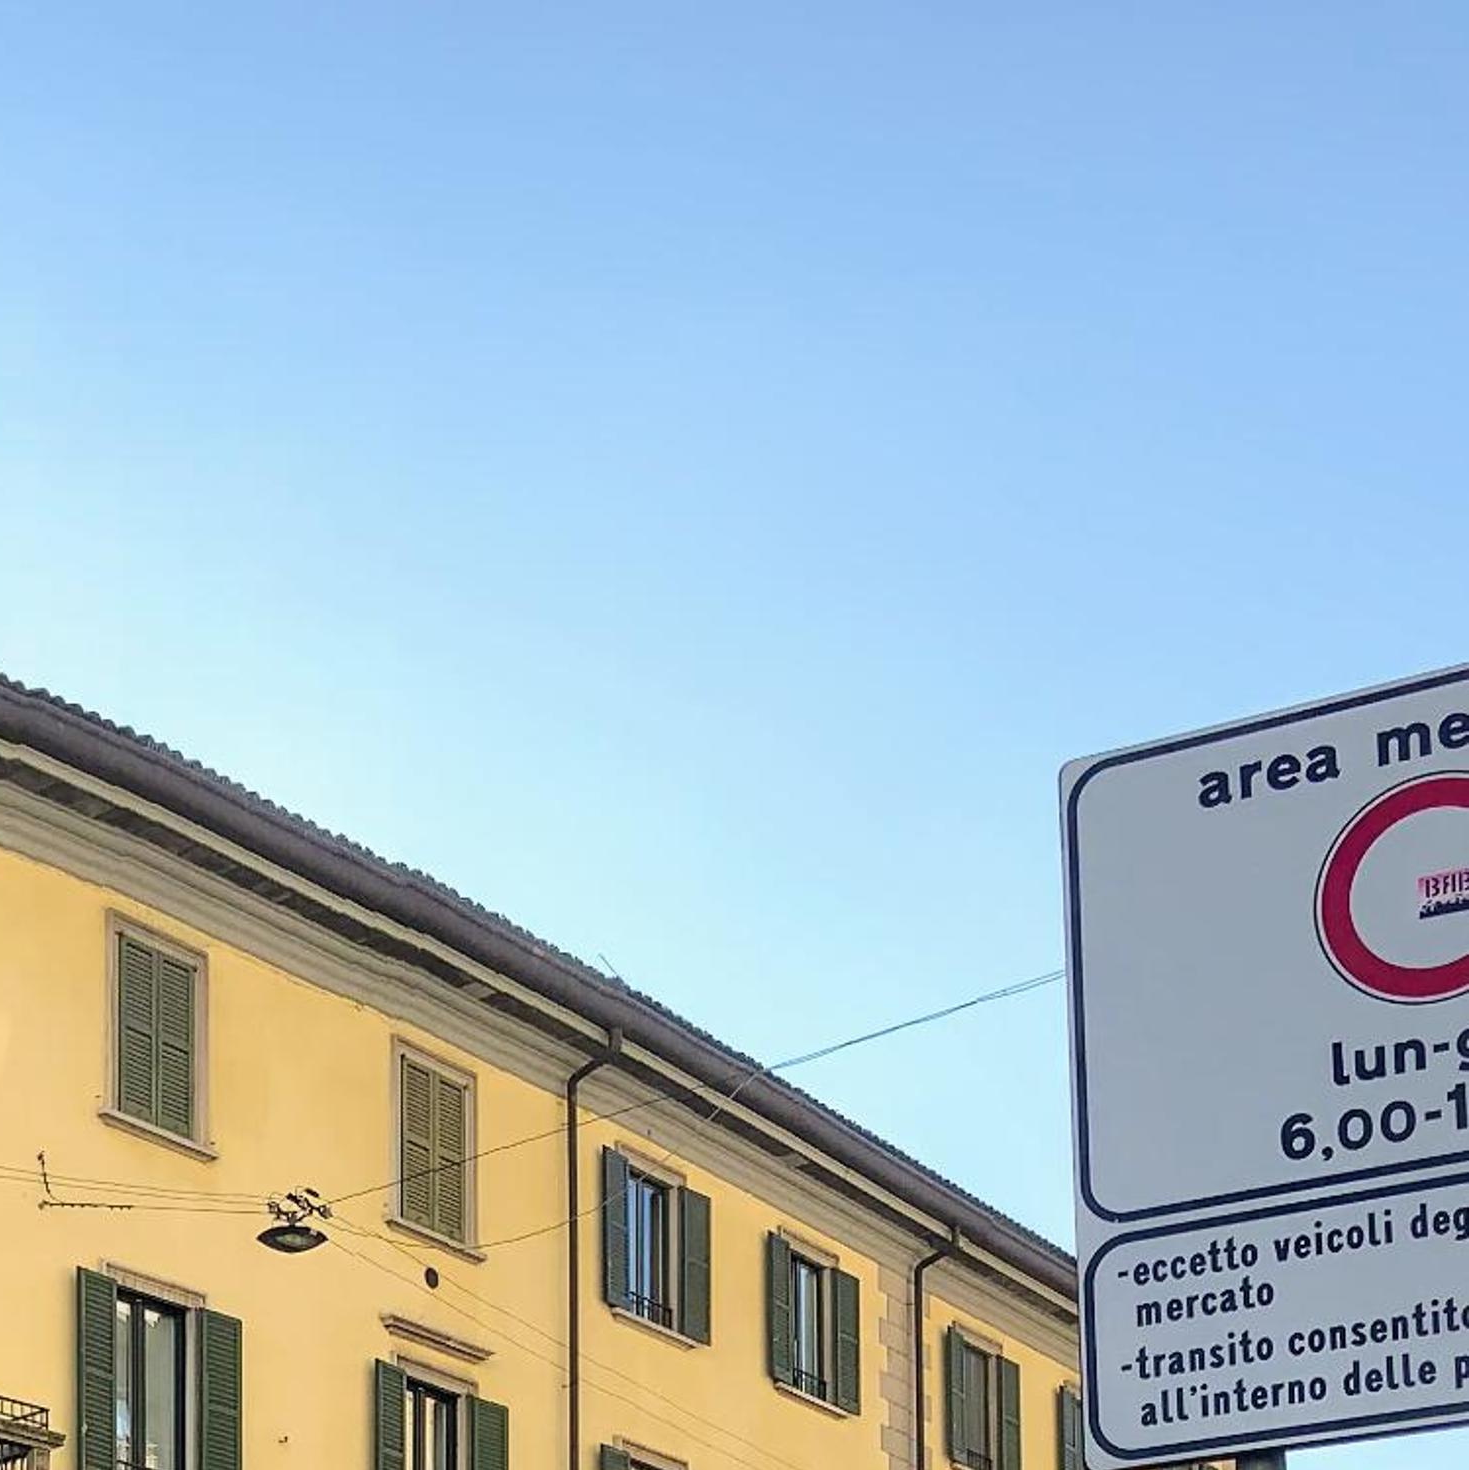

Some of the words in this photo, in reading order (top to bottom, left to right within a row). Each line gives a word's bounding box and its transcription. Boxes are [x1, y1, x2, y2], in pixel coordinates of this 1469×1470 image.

[1199, 746, 1340, 807] area
[1280, 1083, 1468, 1161] 6,00-1
[1118, 1237, 1257, 1286] -eccetto
[1274, 1209, 1392, 1262] veicoli
[1137, 1276, 1273, 1327] mercato
[1122, 1330, 1273, 1380] -transito
[1141, 1378, 1326, 1427] all'interno
[1344, 1354, 1437, 1397] delle
